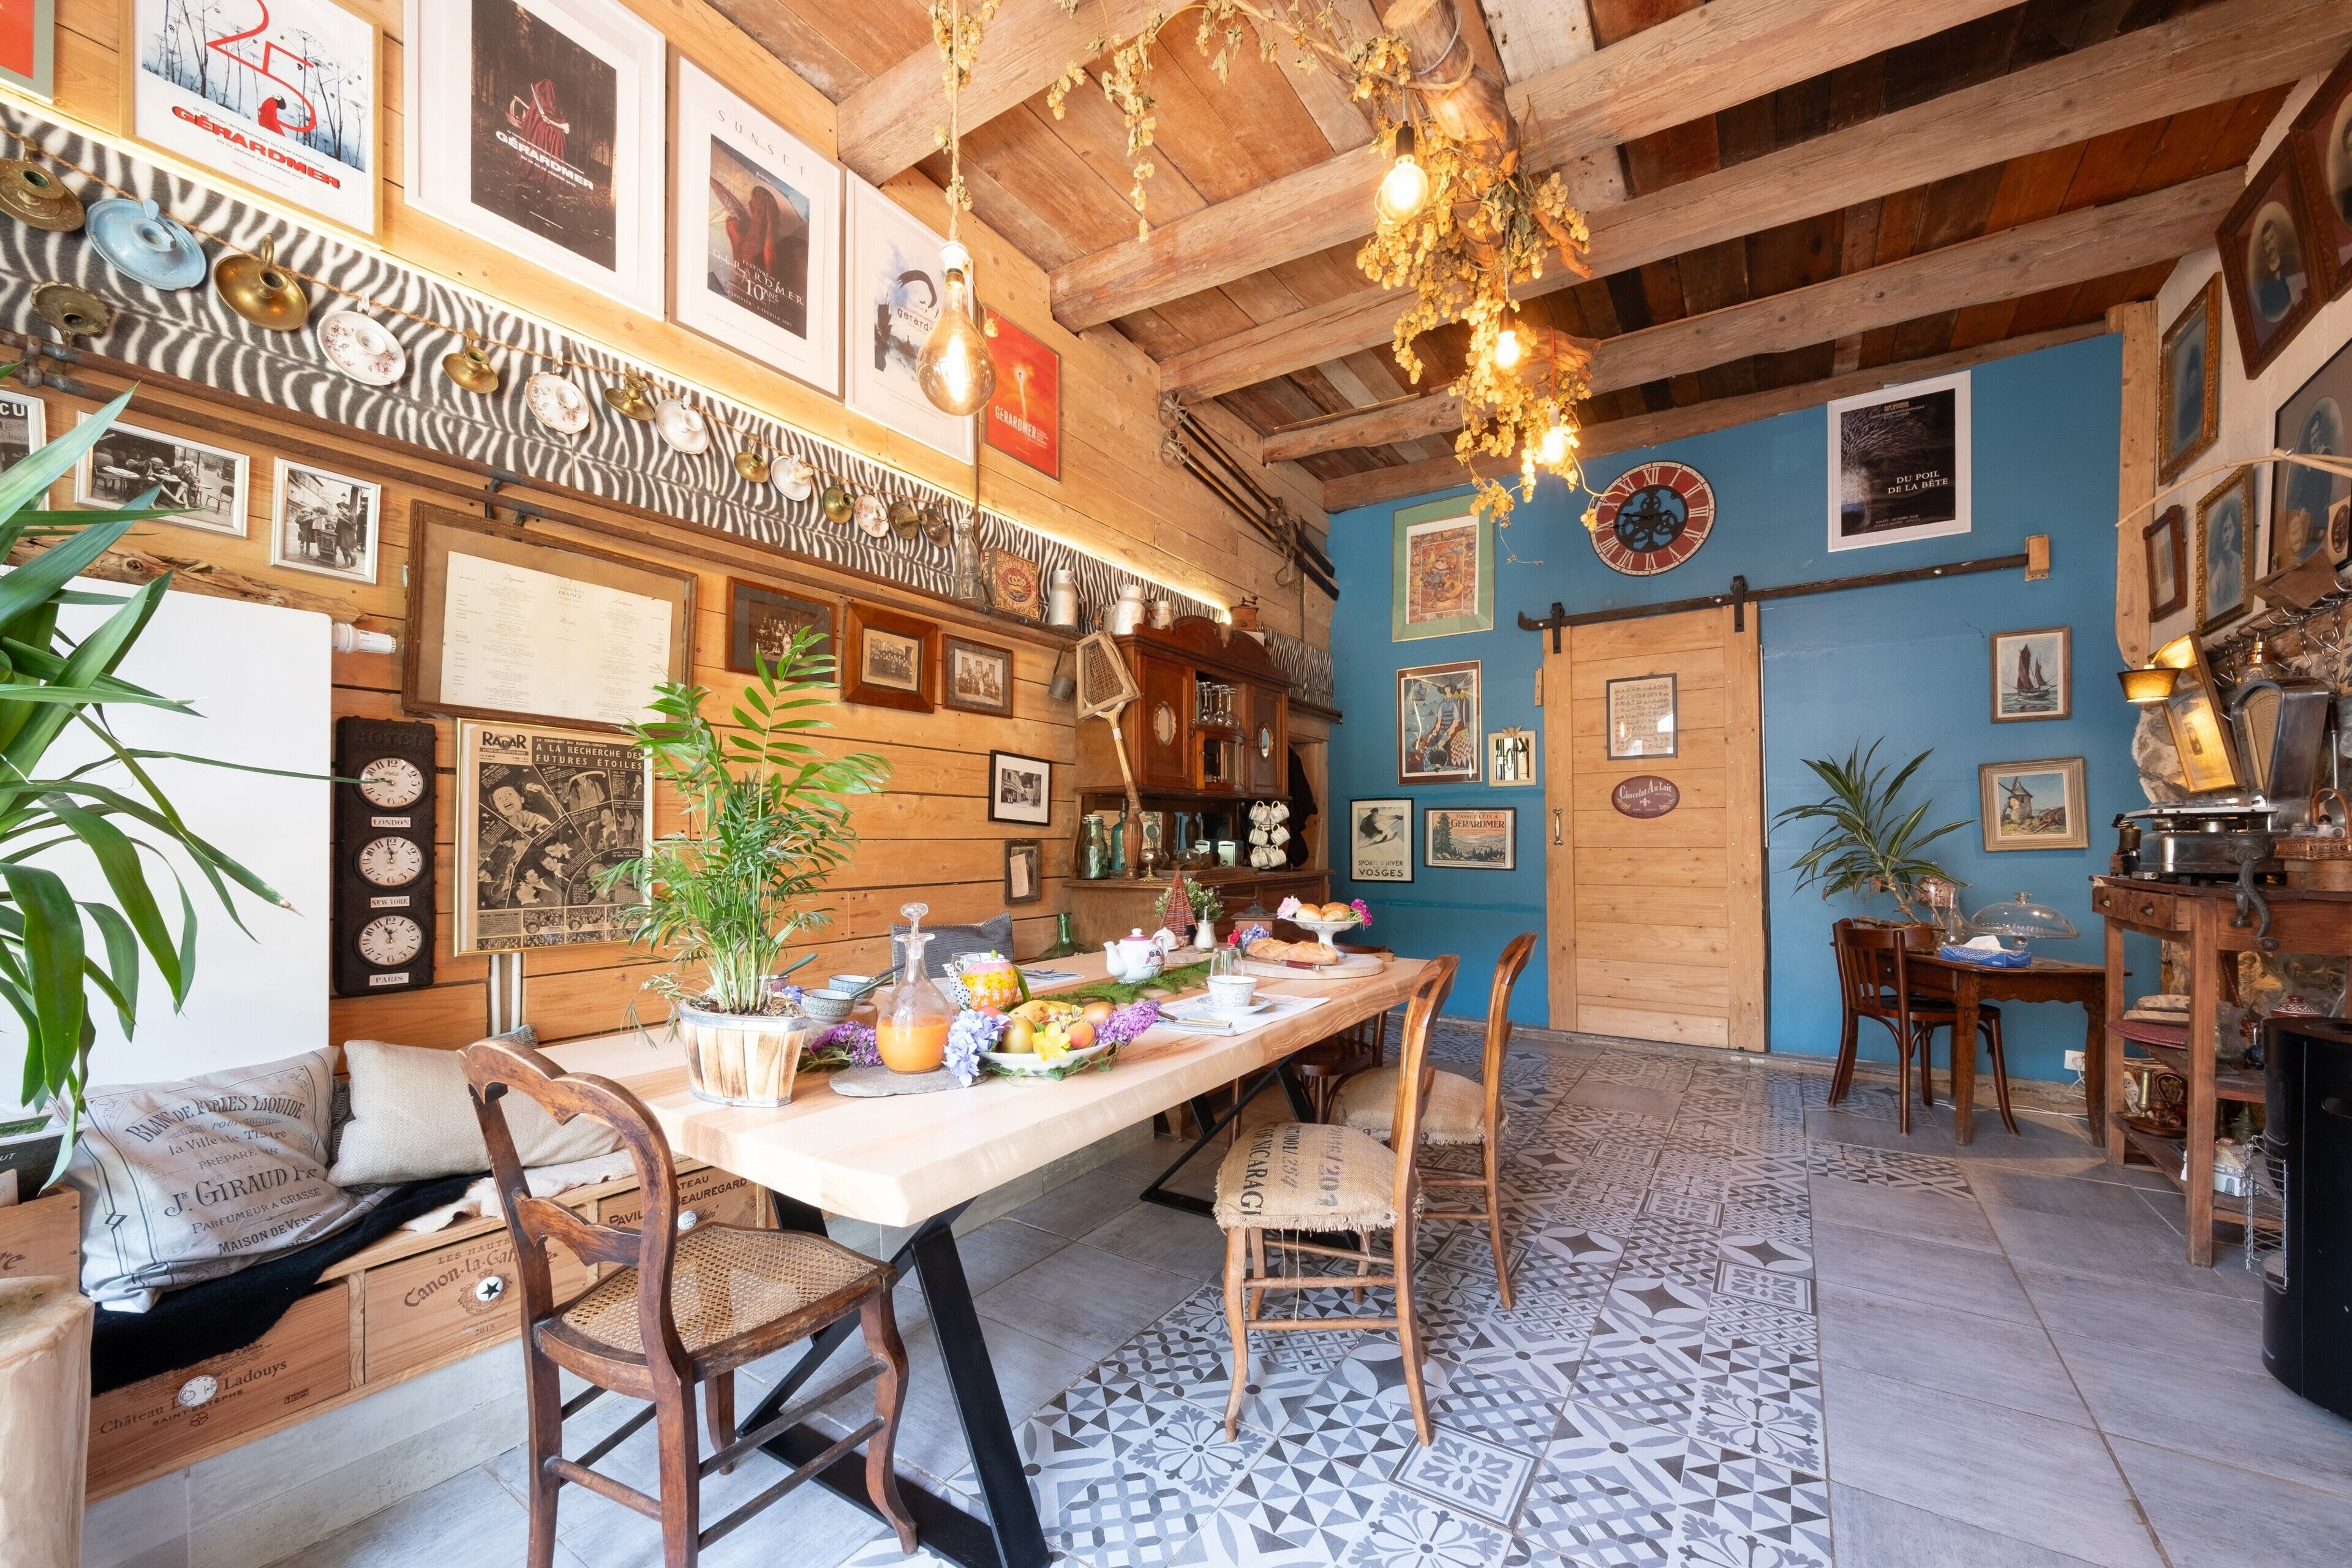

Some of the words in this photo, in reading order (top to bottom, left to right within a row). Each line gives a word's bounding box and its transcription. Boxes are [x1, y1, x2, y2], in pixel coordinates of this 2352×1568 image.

[172, 105, 341, 190] GÉRARDMER
[202, 110, 227, 126] FESTIVAL
[228, 123, 270, 144] INTERNATIONAL
[279, 145, 291, 154] FILM
[291, 151, 325, 169] FANTASTIQUE
[718, 110, 805, 175] SUNSET
[233, 145, 257, 159] JANVIER
[496, 130, 594, 190] GÉRARDMER
[742, 259, 771, 278] FESTIVAL
[731, 292, 752, 306] JANVIER
[745, 279, 764, 301] 10
[764, 288, 780, 300] ANS
[995, 405, 1036, 440] GÉRARDMER
[1888, 486, 1902, 494] DE
[1921, 478, 1948, 488] BÊTE
[1896, 475, 1912, 484] DU
[1916, 470, 1940, 481] POIL
[1007, 574, 1027, 588] COOP
[559, 590, 582, 600] FRANCE
[536, 754, 587, 766] FUTURES
[597, 758, 642, 770] ÉTOILES
[549, 744, 561, 753] LA
[567, 746, 621, 758] RECHERCHE
[1619, 785, 1646, 799] Chocolat
[1648, 779, 1658, 794] Au
[1659, 782, 1672, 792] Lait
[172, 1107, 195, 1123] DE
[250, 1095, 306, 1120] LIQUIDE
[1254, 1129, 1275, 1140] OF
[168, 1145, 186, 1156] la
[185, 1136, 219, 1151] Ville
[198, 1148, 257, 1170] PREPARE
[195, 1168, 288, 1208] GIRAUD
[191, 1202, 270, 1234] PARFUMEUR
[280, 1187, 322, 1206] GRASSE
[217, 1231, 270, 1256] MAISON
[271, 1224, 286, 1237] DE
[438, 1252, 461, 1265] LES
[469, 1237, 510, 1256] HAUTS
[475, 1323, 496, 1336] 2015
[224, 1360, 288, 1391] Ladouys
[100, 1403, 164, 1435] Château
[152, 1389, 244, 1427] SAINT-ESTÈPHE
